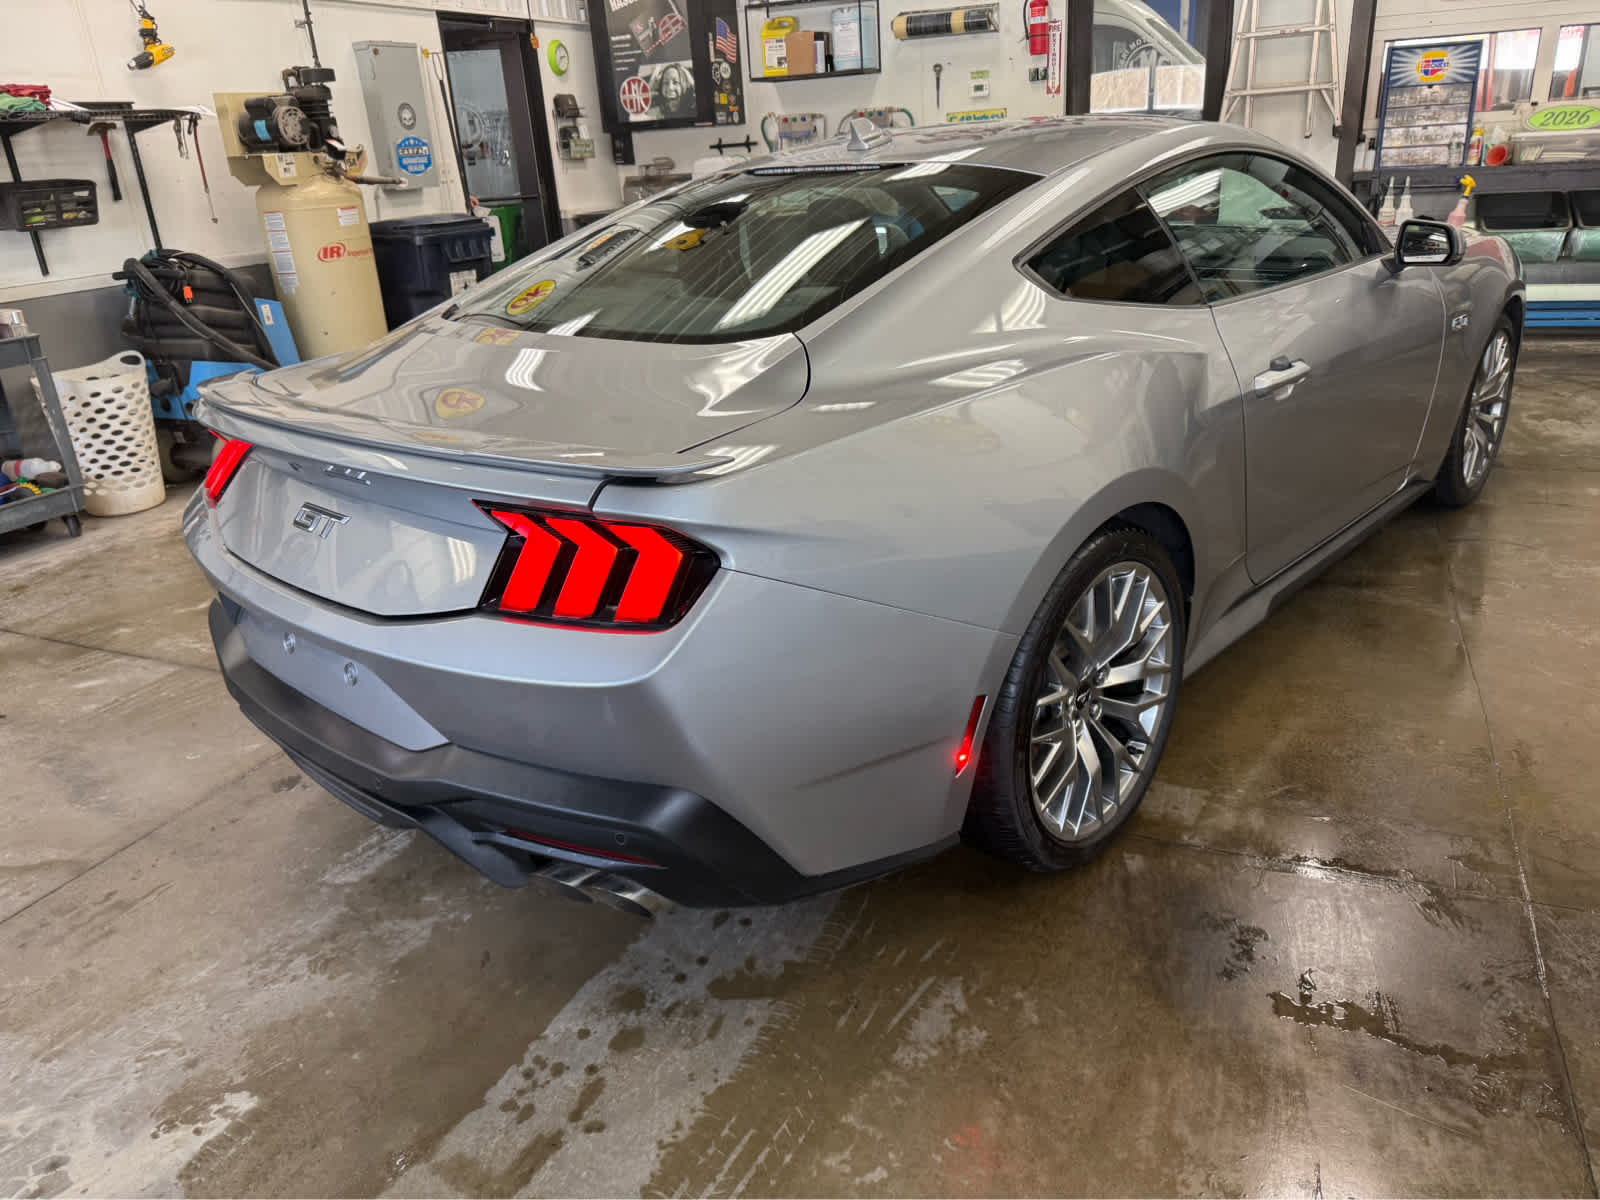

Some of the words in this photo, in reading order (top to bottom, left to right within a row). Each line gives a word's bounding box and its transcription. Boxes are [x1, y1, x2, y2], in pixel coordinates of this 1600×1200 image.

[1048, 24, 1061, 32] FIRE
[1540, 109, 1594, 127] 2026
[322, 246, 343, 260] IR
[293, 501, 352, 539] GT
